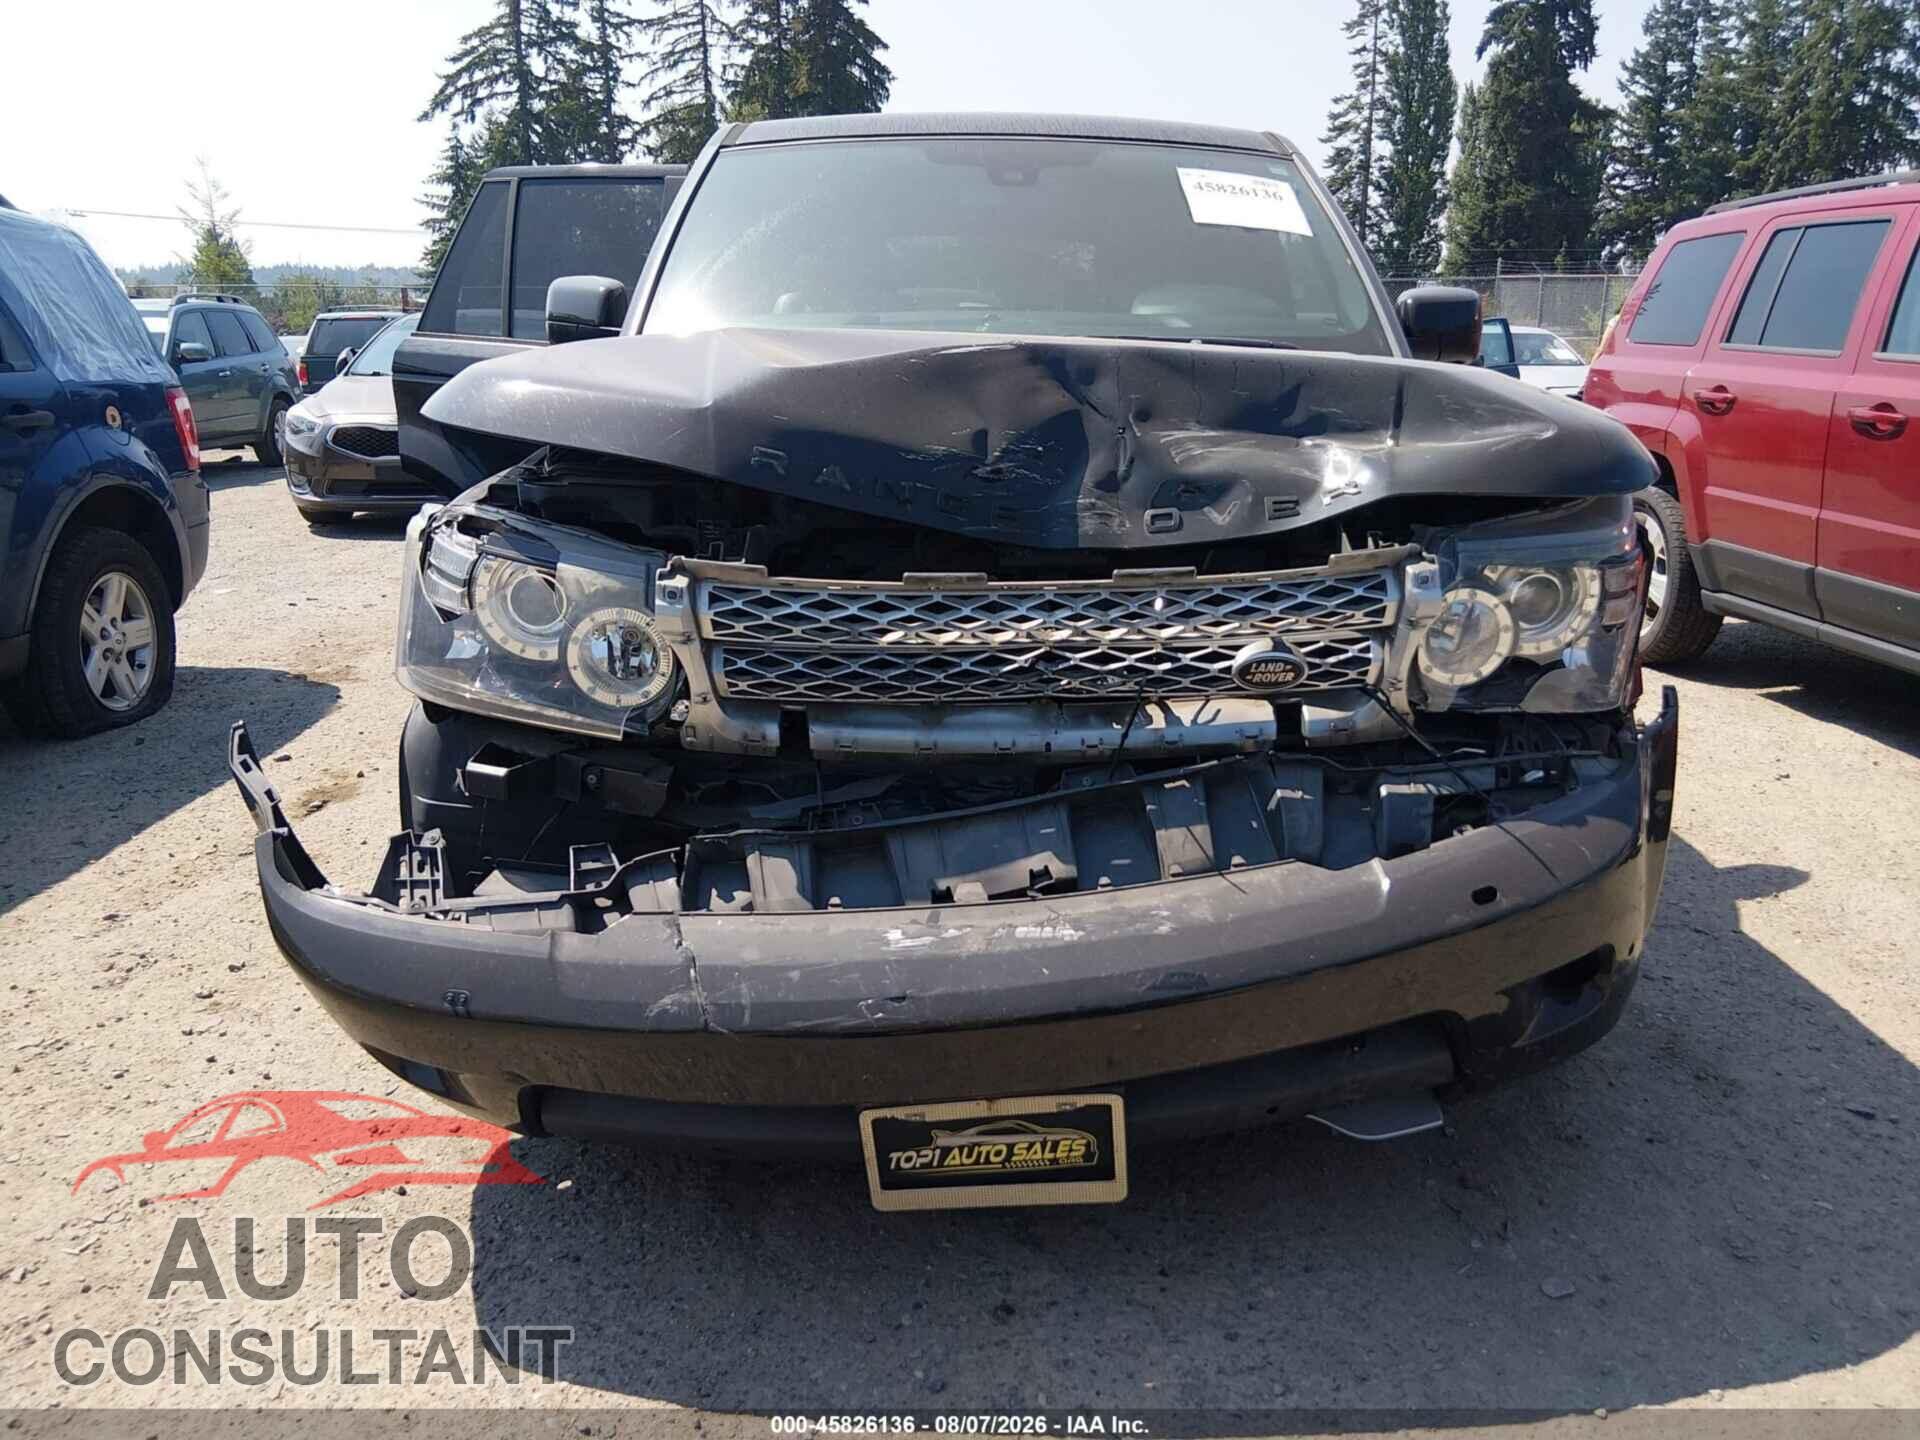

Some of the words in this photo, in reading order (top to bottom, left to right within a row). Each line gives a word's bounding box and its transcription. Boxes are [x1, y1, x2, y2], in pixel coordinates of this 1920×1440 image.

[1250, 661, 1283, 673] LAND
[1252, 672, 1295, 683] ROVER
[943, 1144, 1007, 1167] AUTO
[1011, 1138, 1088, 1161] SALES
